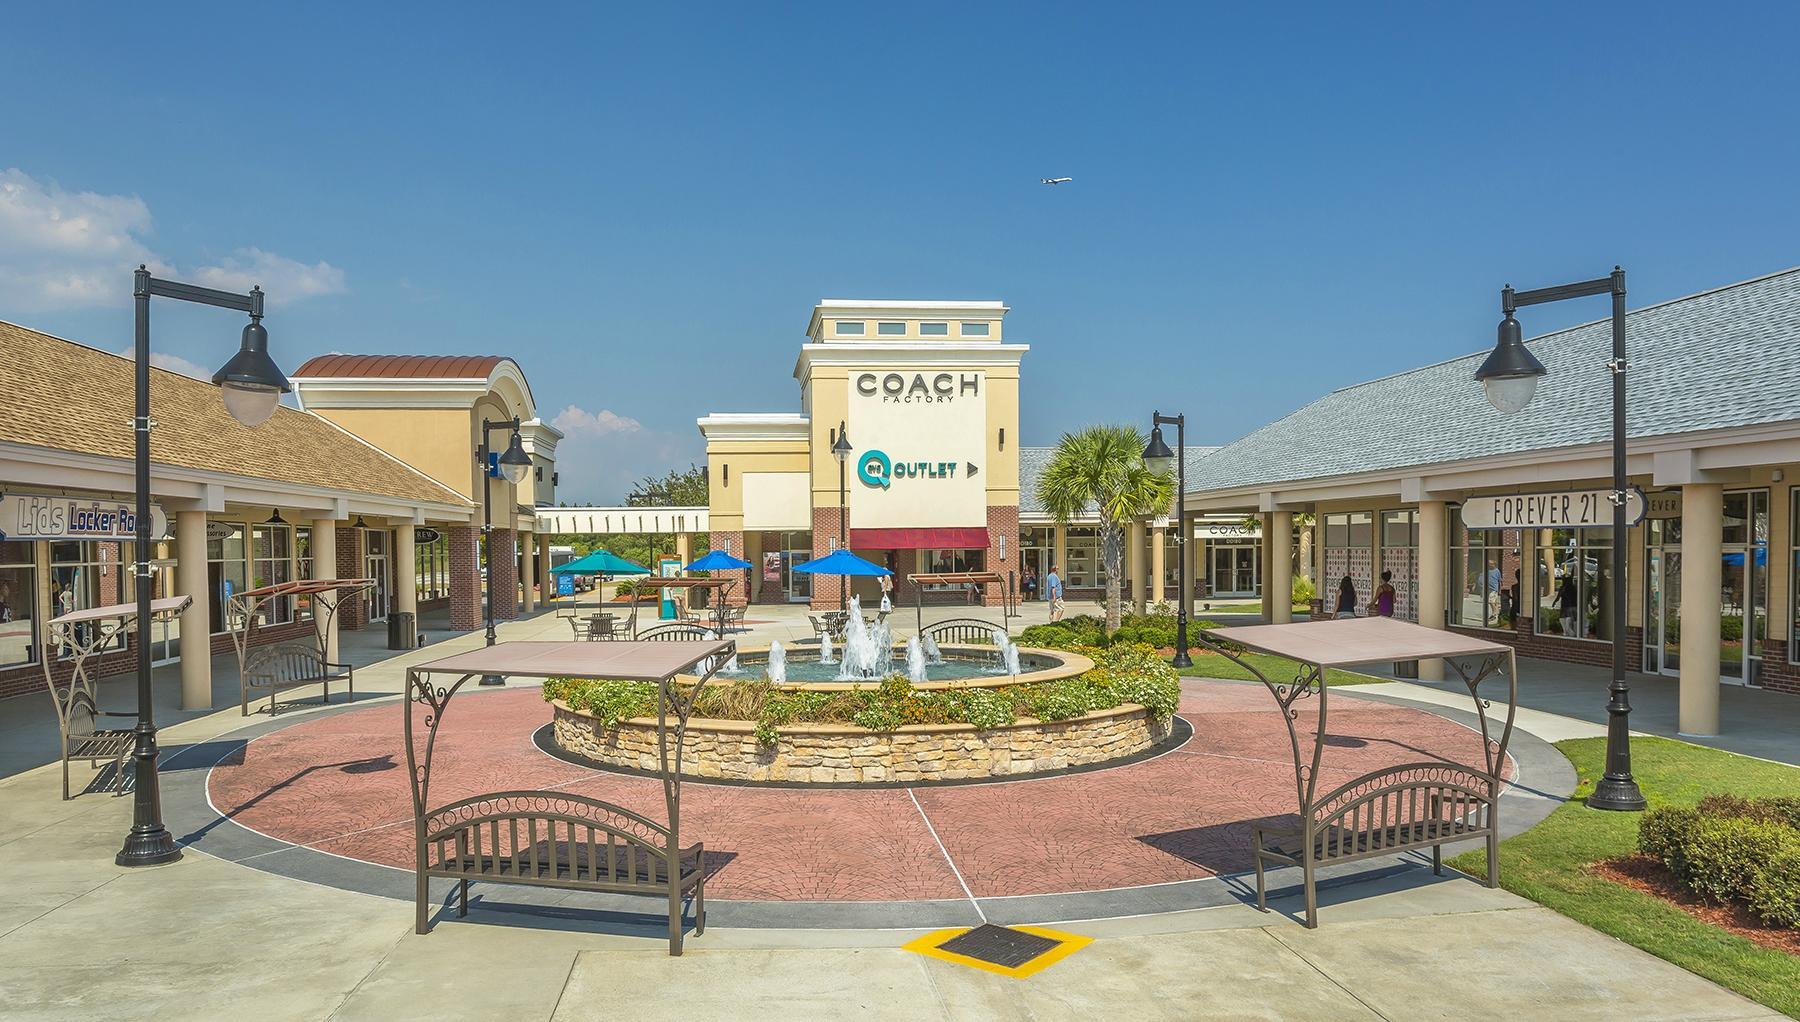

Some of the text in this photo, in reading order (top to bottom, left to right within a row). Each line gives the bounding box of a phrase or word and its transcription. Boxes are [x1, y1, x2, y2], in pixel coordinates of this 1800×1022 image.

[857, 373, 978, 396] COACH
[894, 462, 957, 478] OUTLET
[1494, 493, 1597, 525] FOREVER 21
[1651, 499, 1677, 511] EVER
[17, 498, 154, 536] Lids Locker Ro
[416, 530, 434, 538] REW
